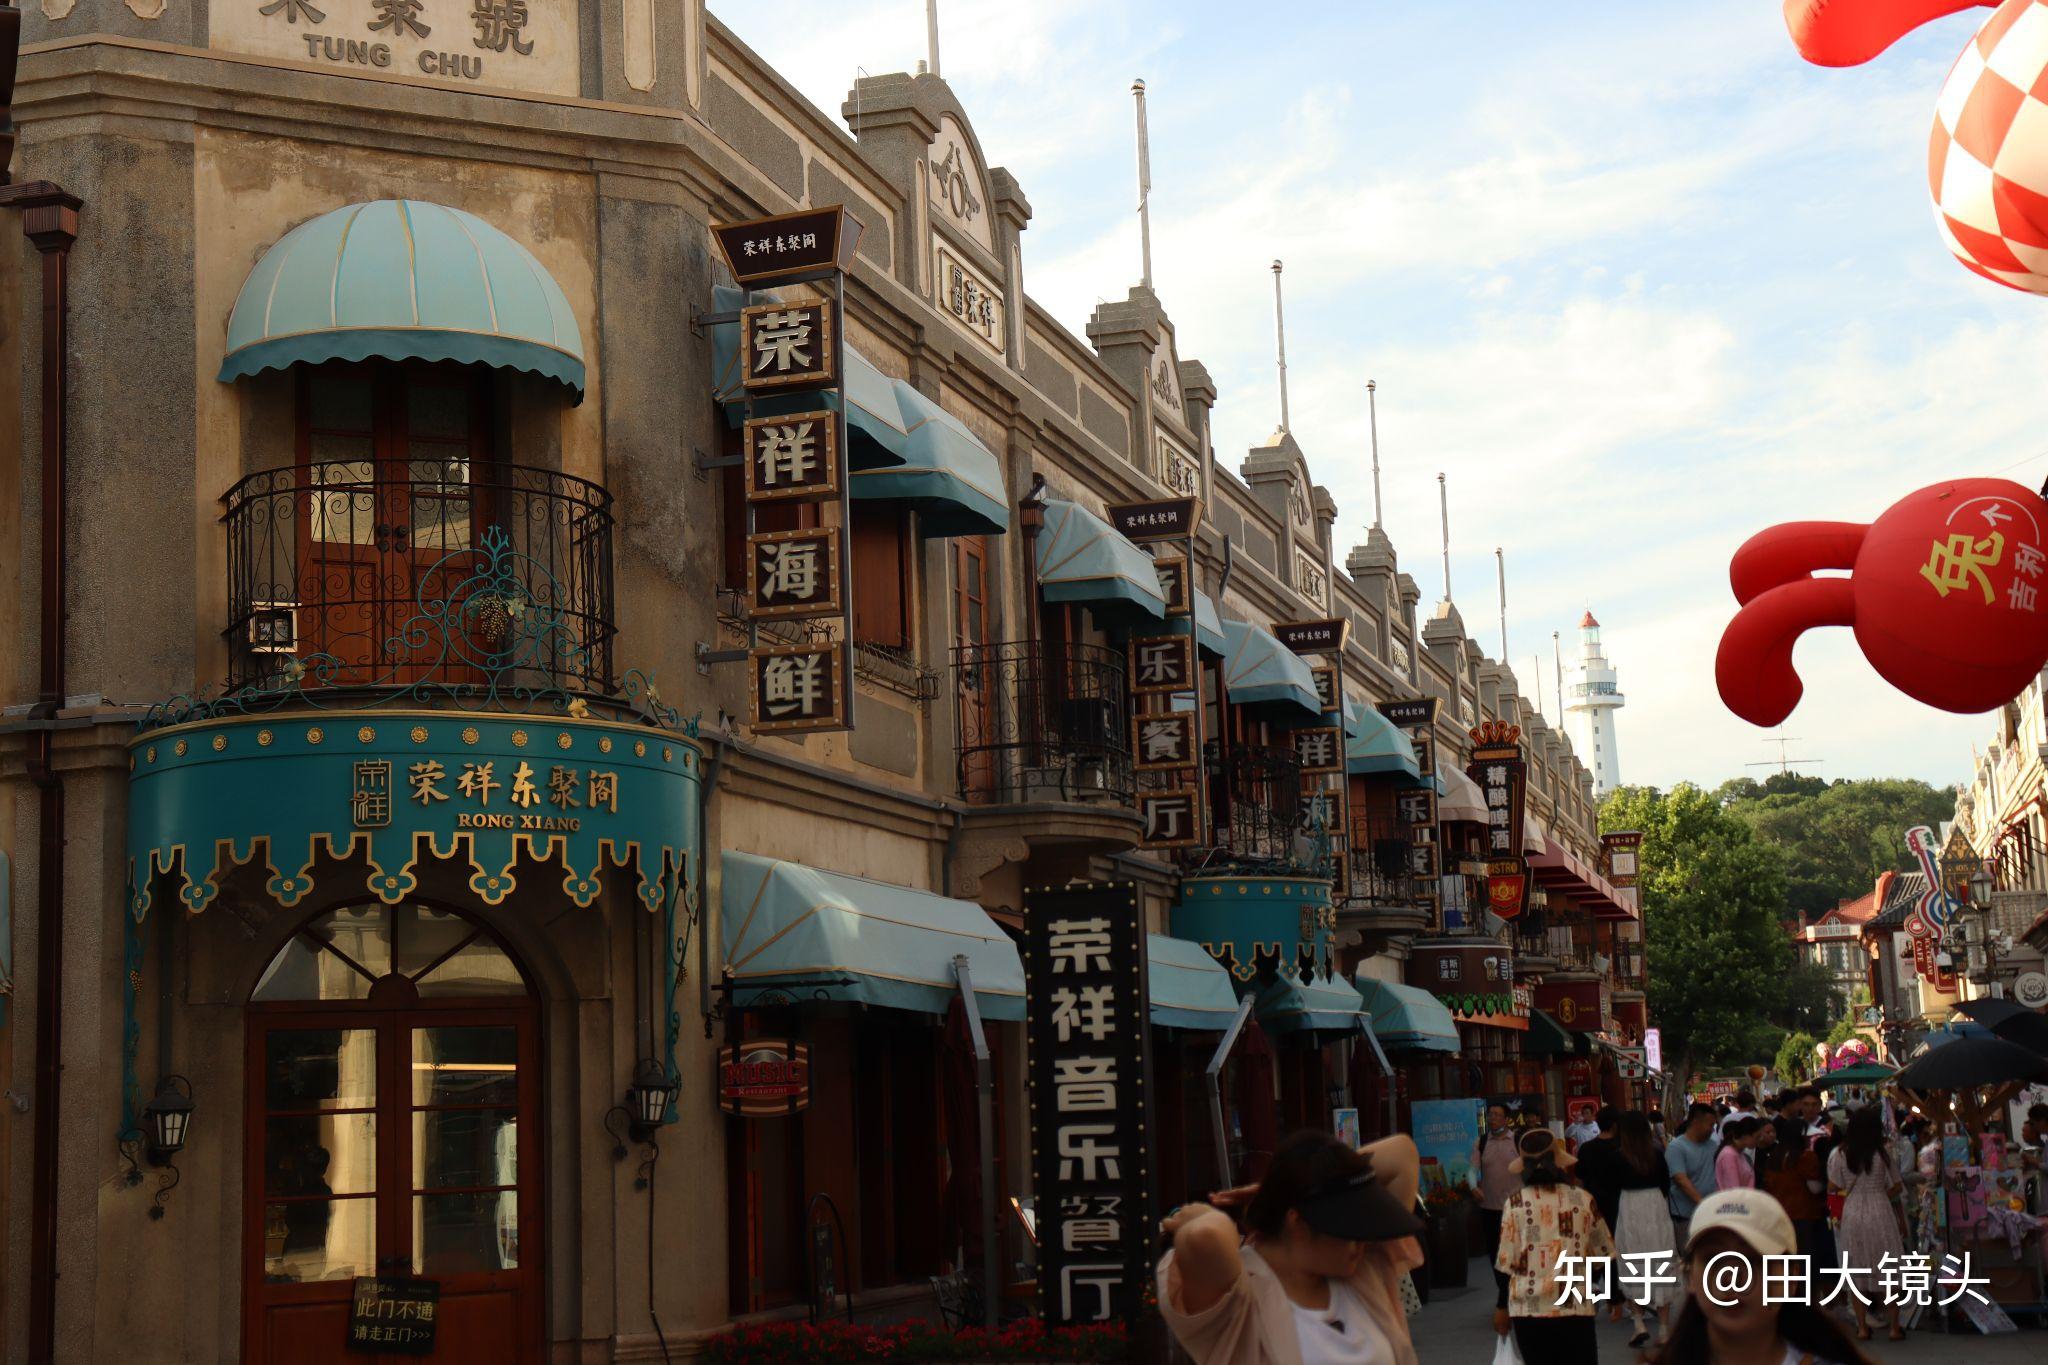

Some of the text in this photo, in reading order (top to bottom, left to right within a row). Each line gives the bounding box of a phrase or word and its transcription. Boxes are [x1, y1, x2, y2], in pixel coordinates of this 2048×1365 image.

[303, 33, 482, 79] TUNG CHU
[743, 233, 816, 256] 荣祥东聚阁
[753, 310, 824, 716] 荣祥海鲜
[1919, 530, 2005, 606] 兔
[2007, 541, 2047, 613] 吉利
[408, 760, 619, 814] 荣祥东聚阁
[1487, 765, 1510, 849] 精酿啤酒
[458, 813, 581, 832] RONG XIANG
[727, 1060, 801, 1085] MUSIC
[1047, 917, 1125, 1321] 荣祥音乐餐厅
[356, 1298, 433, 1321] 此门不通
